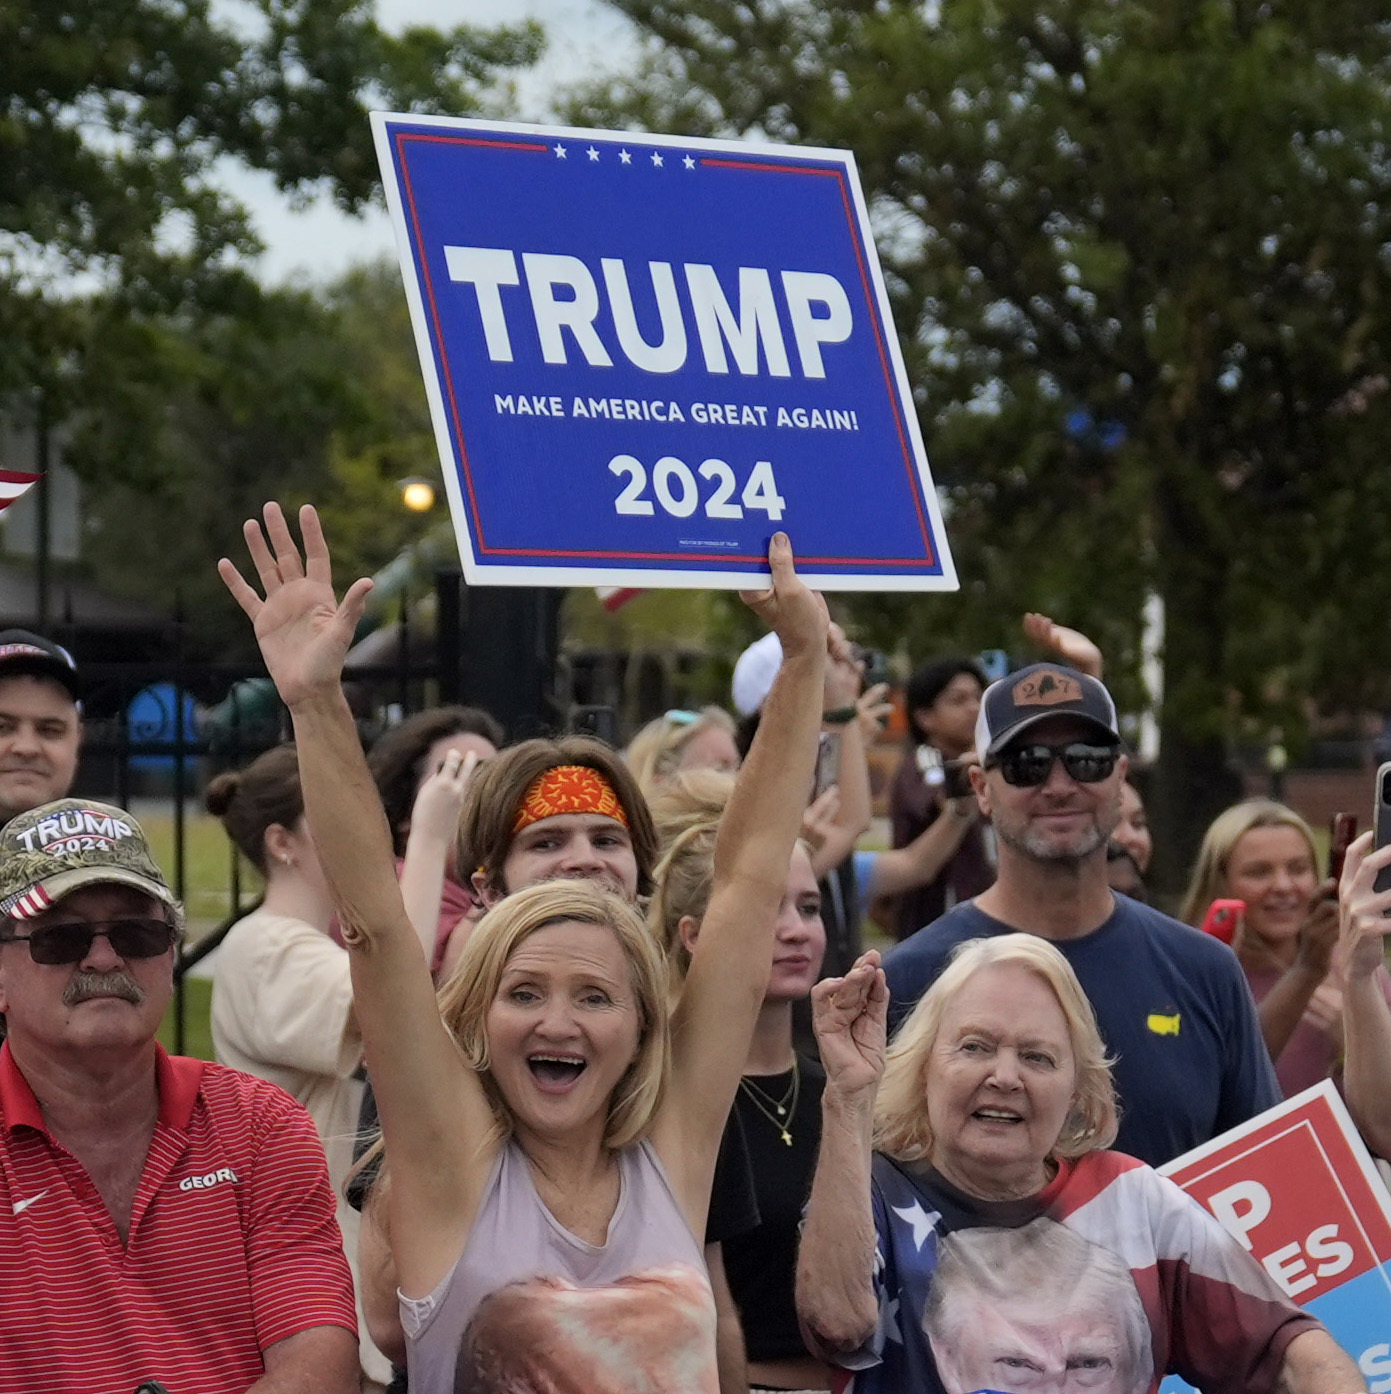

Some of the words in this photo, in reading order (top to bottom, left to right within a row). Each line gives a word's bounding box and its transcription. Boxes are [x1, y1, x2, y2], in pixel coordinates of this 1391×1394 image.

[443, 246, 853, 379] TRUMP
[494, 394, 564, 418] MAKE
[573, 398, 685, 423] AMERICA
[691, 403, 768, 426] GREAT
[776, 407, 859, 430] AGAIN!
[608, 454, 786, 520] 2024
[16, 813, 133, 853] TRUMP
[54, 837, 109, 857] 2024
[179, 1167, 238, 1192] GEOR
